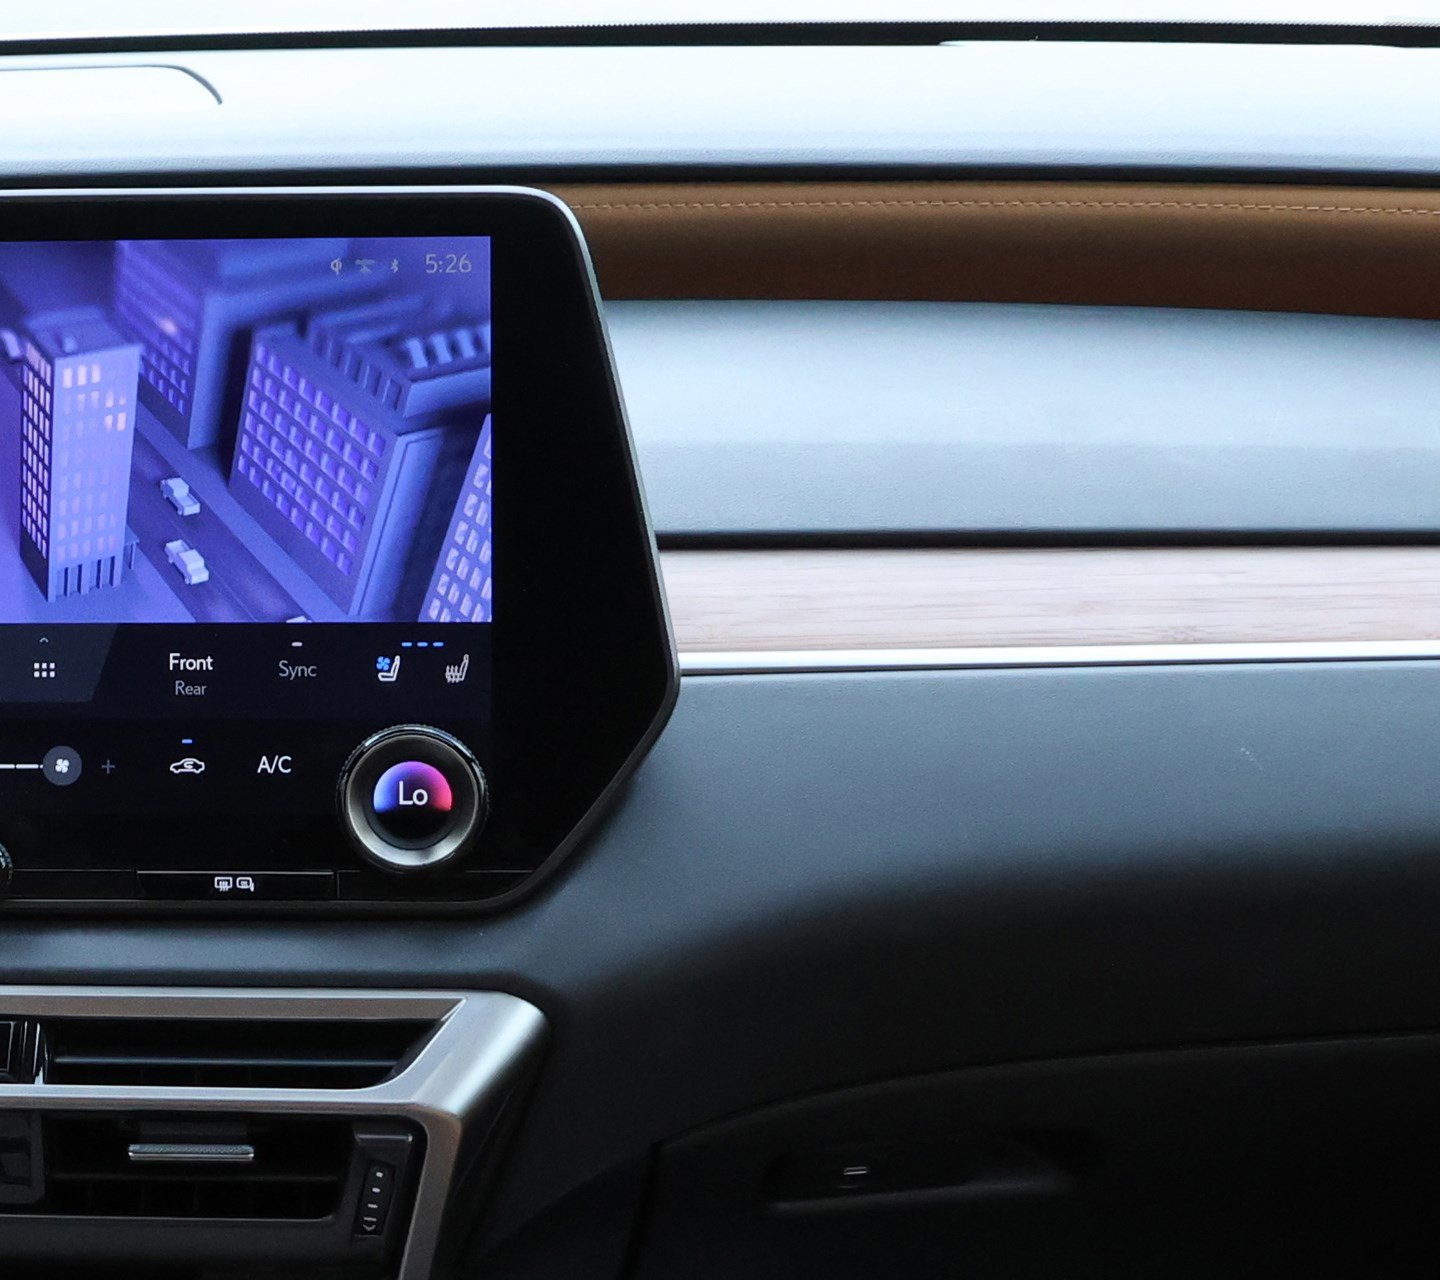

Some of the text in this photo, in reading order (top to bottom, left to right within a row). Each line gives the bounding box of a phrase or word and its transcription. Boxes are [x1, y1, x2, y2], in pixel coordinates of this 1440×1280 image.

[426, 249, 475, 276] 5:26
[170, 653, 213, 670] Front
[279, 660, 316, 680] Sync
[176, 681, 206, 695] Rear
[258, 756, 291, 773] A/C
[397, 779, 429, 807] Lo
